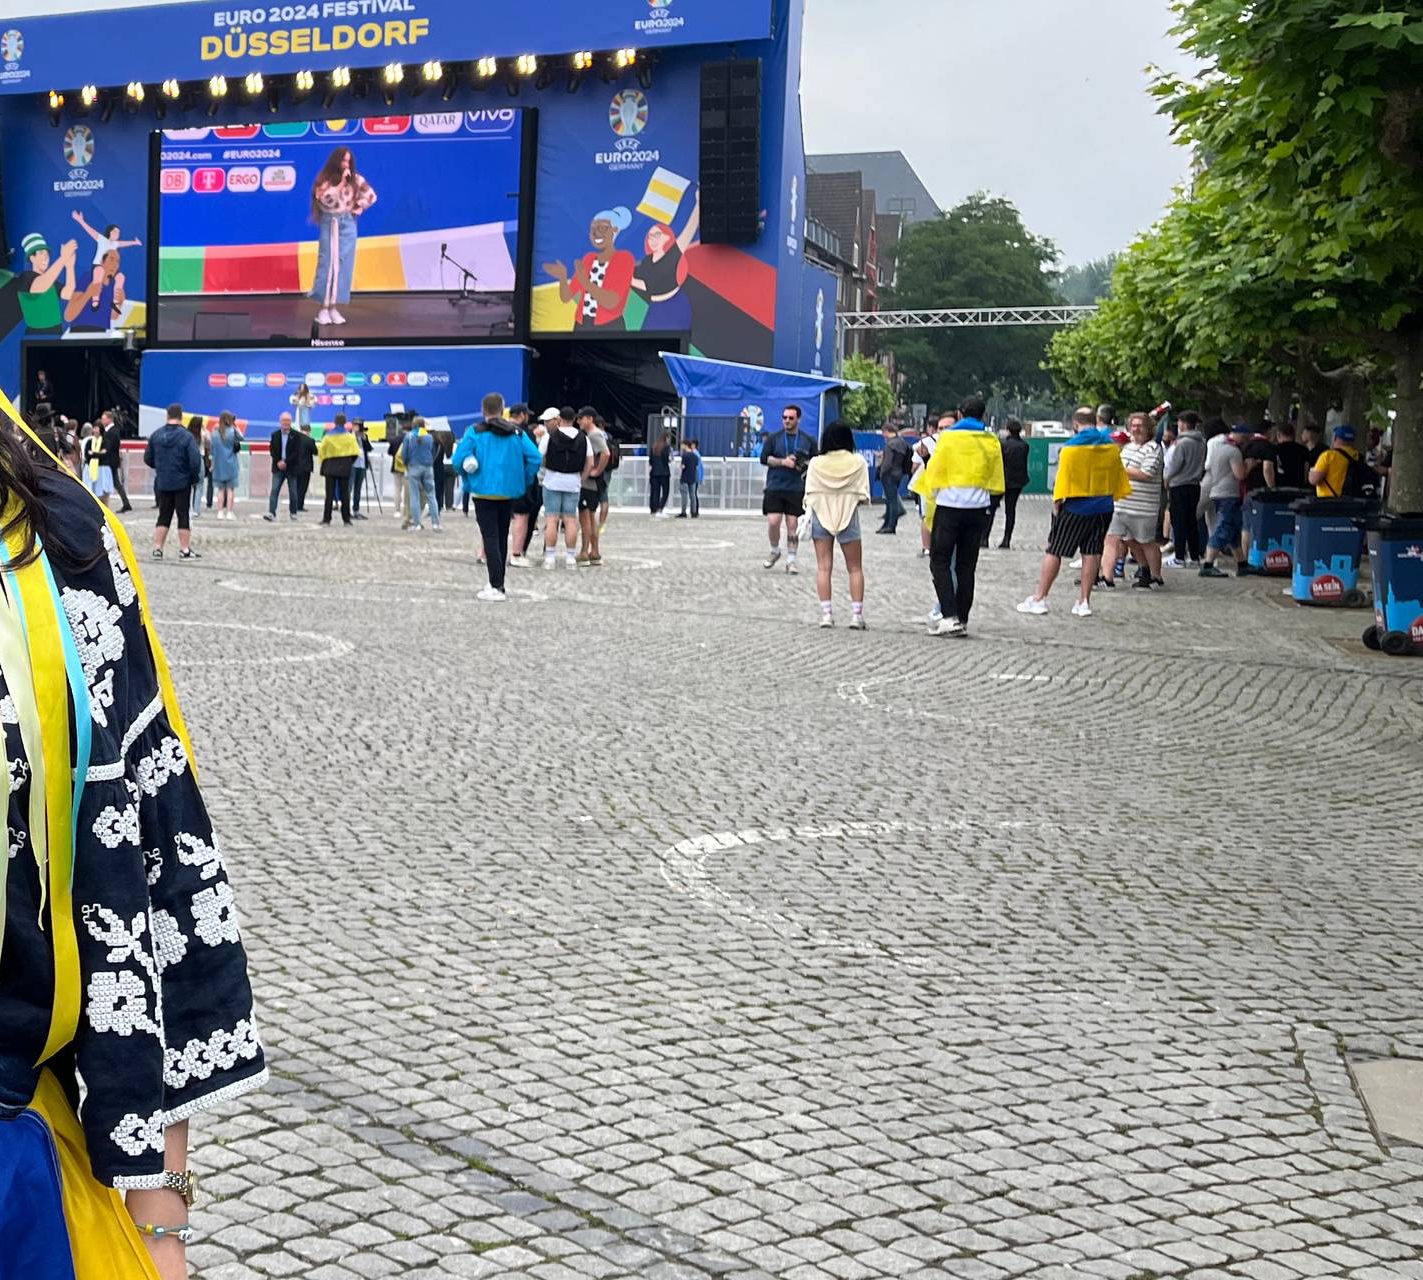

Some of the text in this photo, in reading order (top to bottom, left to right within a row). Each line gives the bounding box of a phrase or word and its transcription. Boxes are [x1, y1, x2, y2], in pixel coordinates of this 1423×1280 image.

[213, 0, 415, 27] EURO 2024 FESTIVAL
[634, 17, 685, 31] EURO2024
[200, 18, 430, 61] DÜSSELDORF
[418, 114, 457, 128] QATAR
[223, 149, 281, 160] #EURO2024
[595, 149, 660, 165] EURO2024
[53, 179, 105, 192] EURO2024
[165, 174, 182, 188] DB
[229, 174, 259, 185] ERGO
